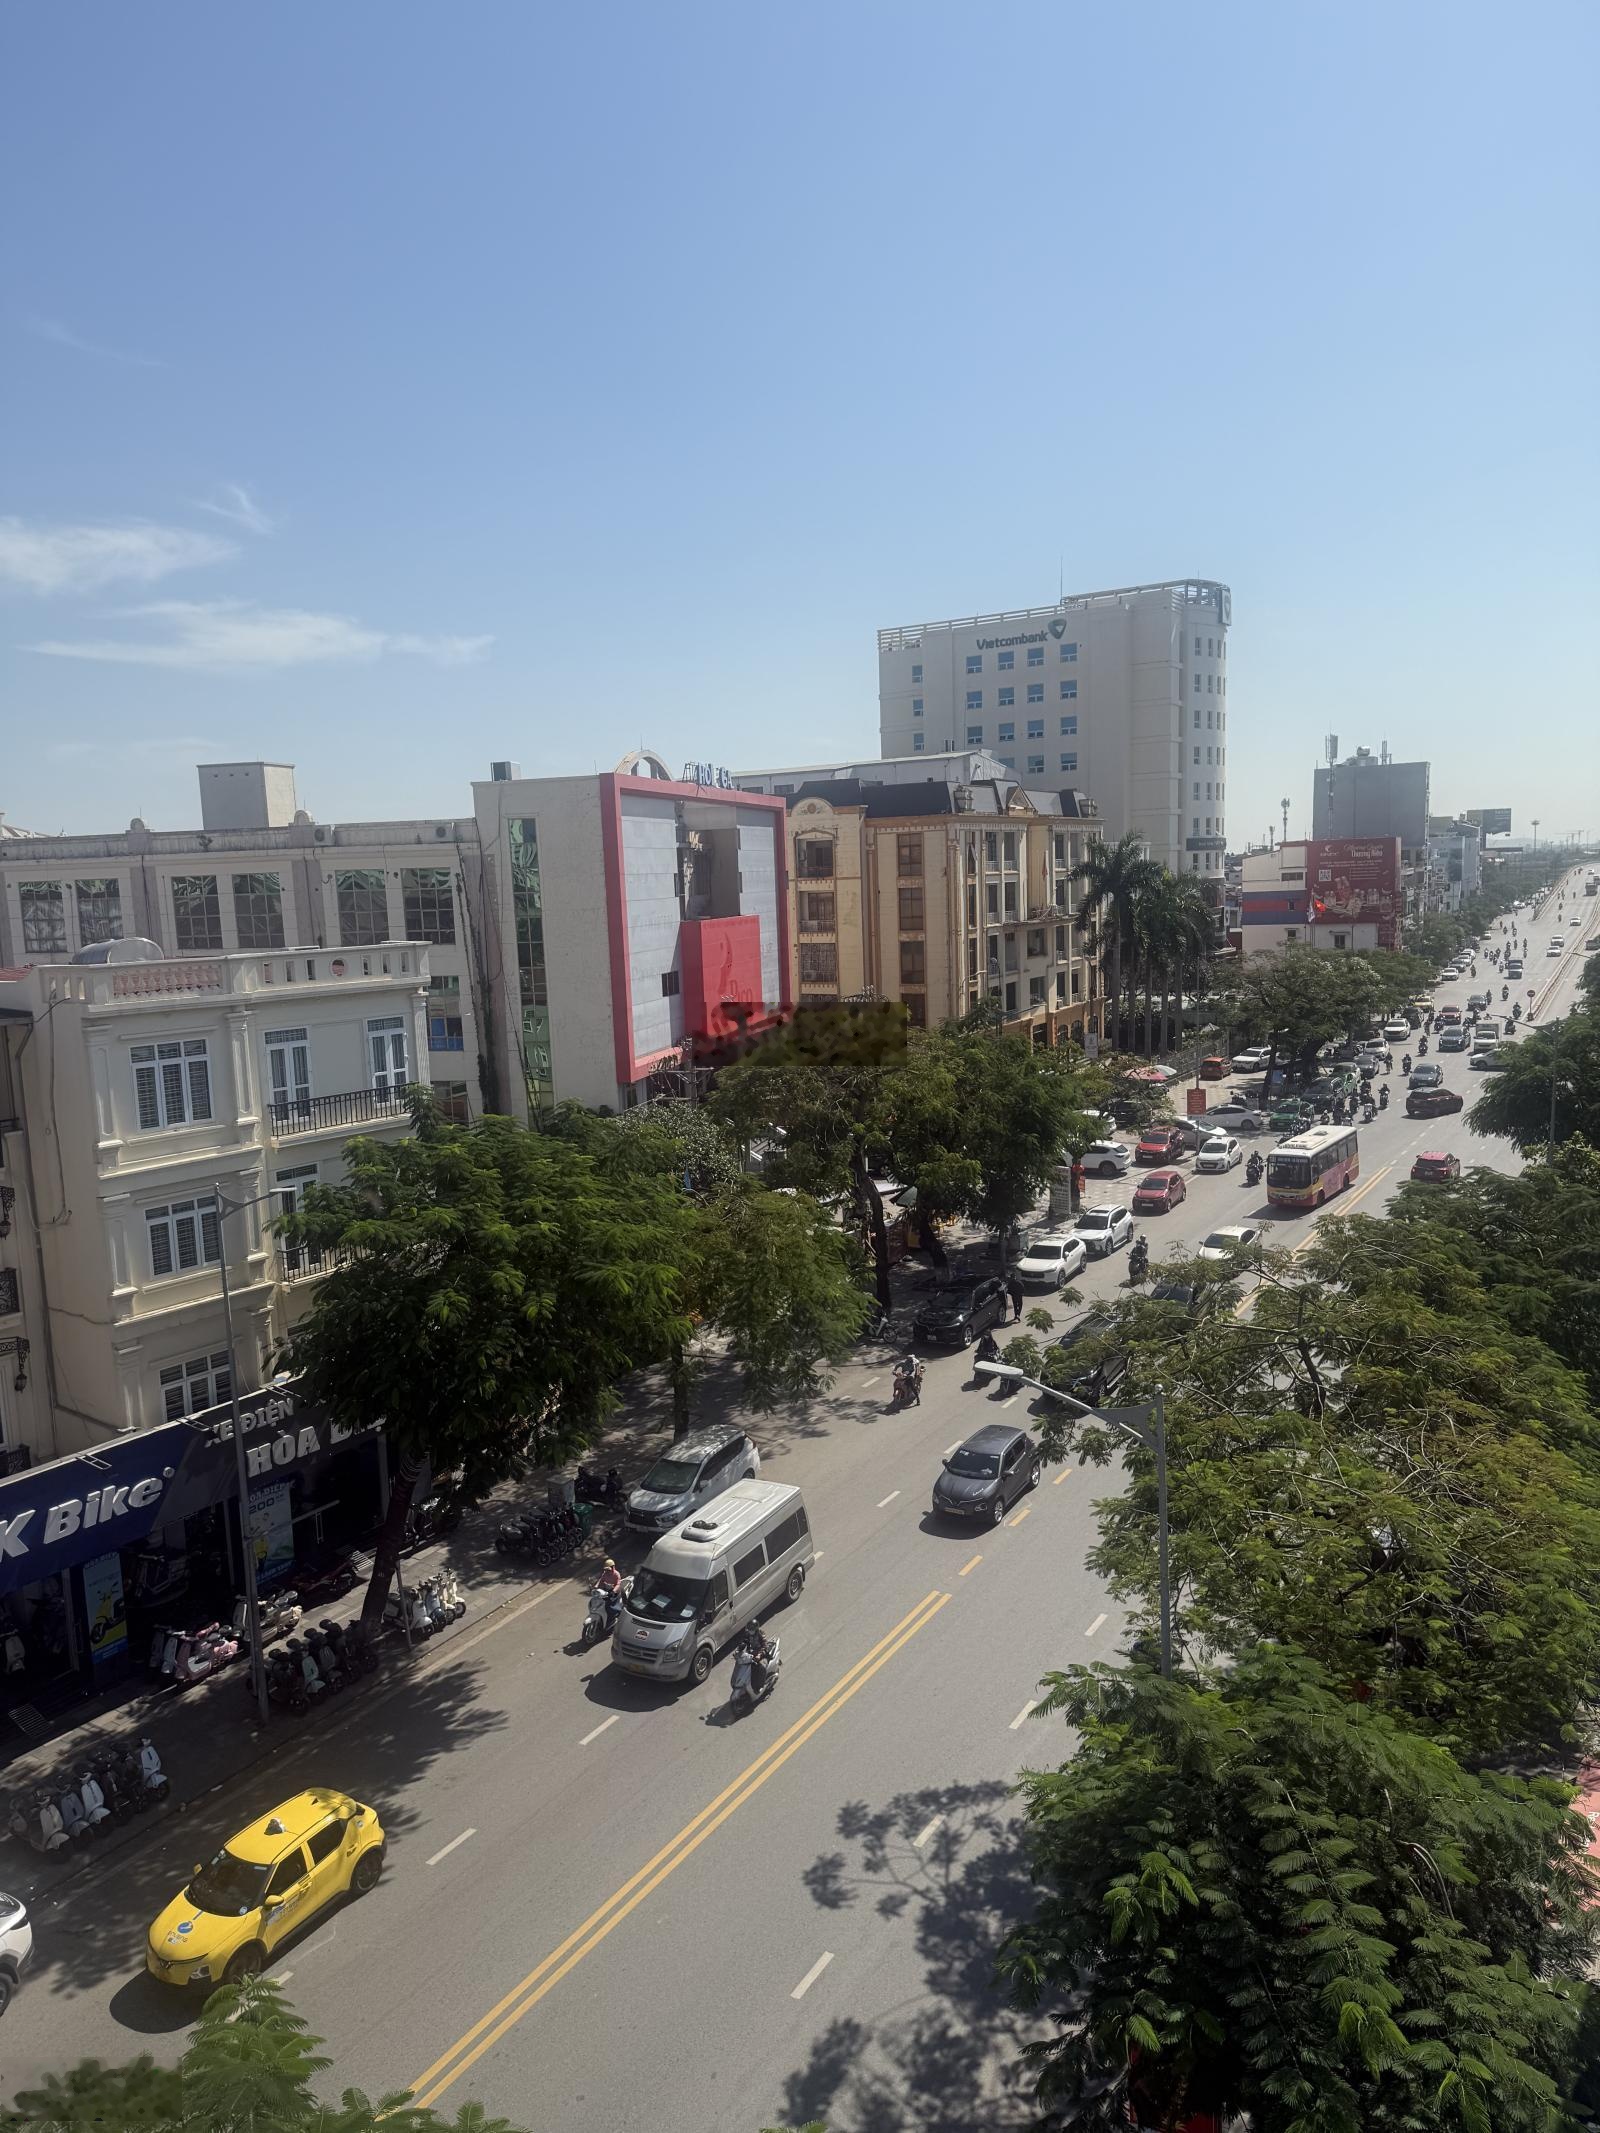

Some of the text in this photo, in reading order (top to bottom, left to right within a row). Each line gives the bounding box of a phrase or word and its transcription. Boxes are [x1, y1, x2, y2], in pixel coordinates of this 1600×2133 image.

[976, 630, 1049, 650] Vietcombank
[204, 1419, 235, 1448] XE
[246, 1425, 321, 1478] HÒA
